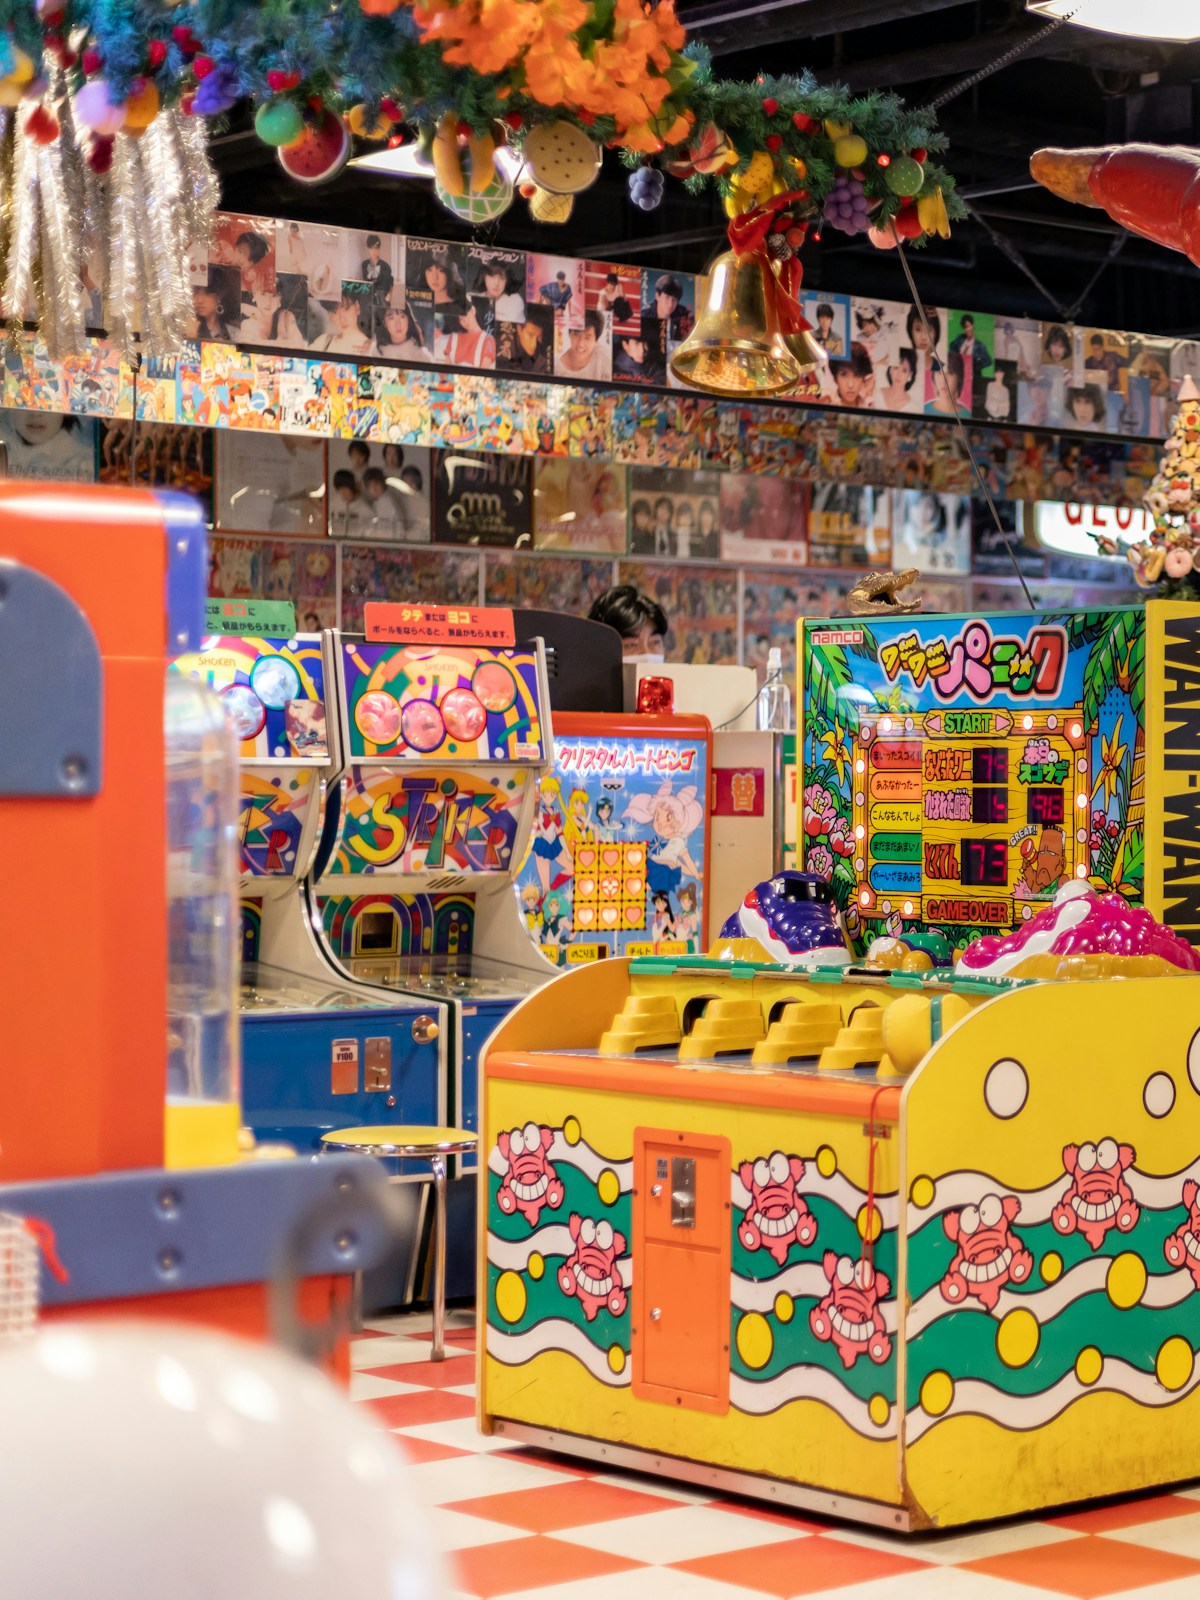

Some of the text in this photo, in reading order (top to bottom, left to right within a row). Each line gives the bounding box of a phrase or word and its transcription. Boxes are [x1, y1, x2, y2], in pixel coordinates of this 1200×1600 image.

[811, 630, 863, 645] namco
[881, 624, 1065, 697] ワニワニパニック
[944, 712, 993, 733] START
[559, 746, 697, 772] クリスタルハートビンゴ
[924, 748, 972, 782] なぐったワニ
[1023, 746, 1059, 764] 本日の
[1018, 761, 1070, 784] スゴウデ
[872, 811, 921, 823] こんなもんでしょ
[1009, 825, 1038, 848] GREAT!!
[924, 842, 961, 881] とくてん
[969, 844, 1007, 883] 73
[873, 871, 921, 883] やーいざまあみろ
